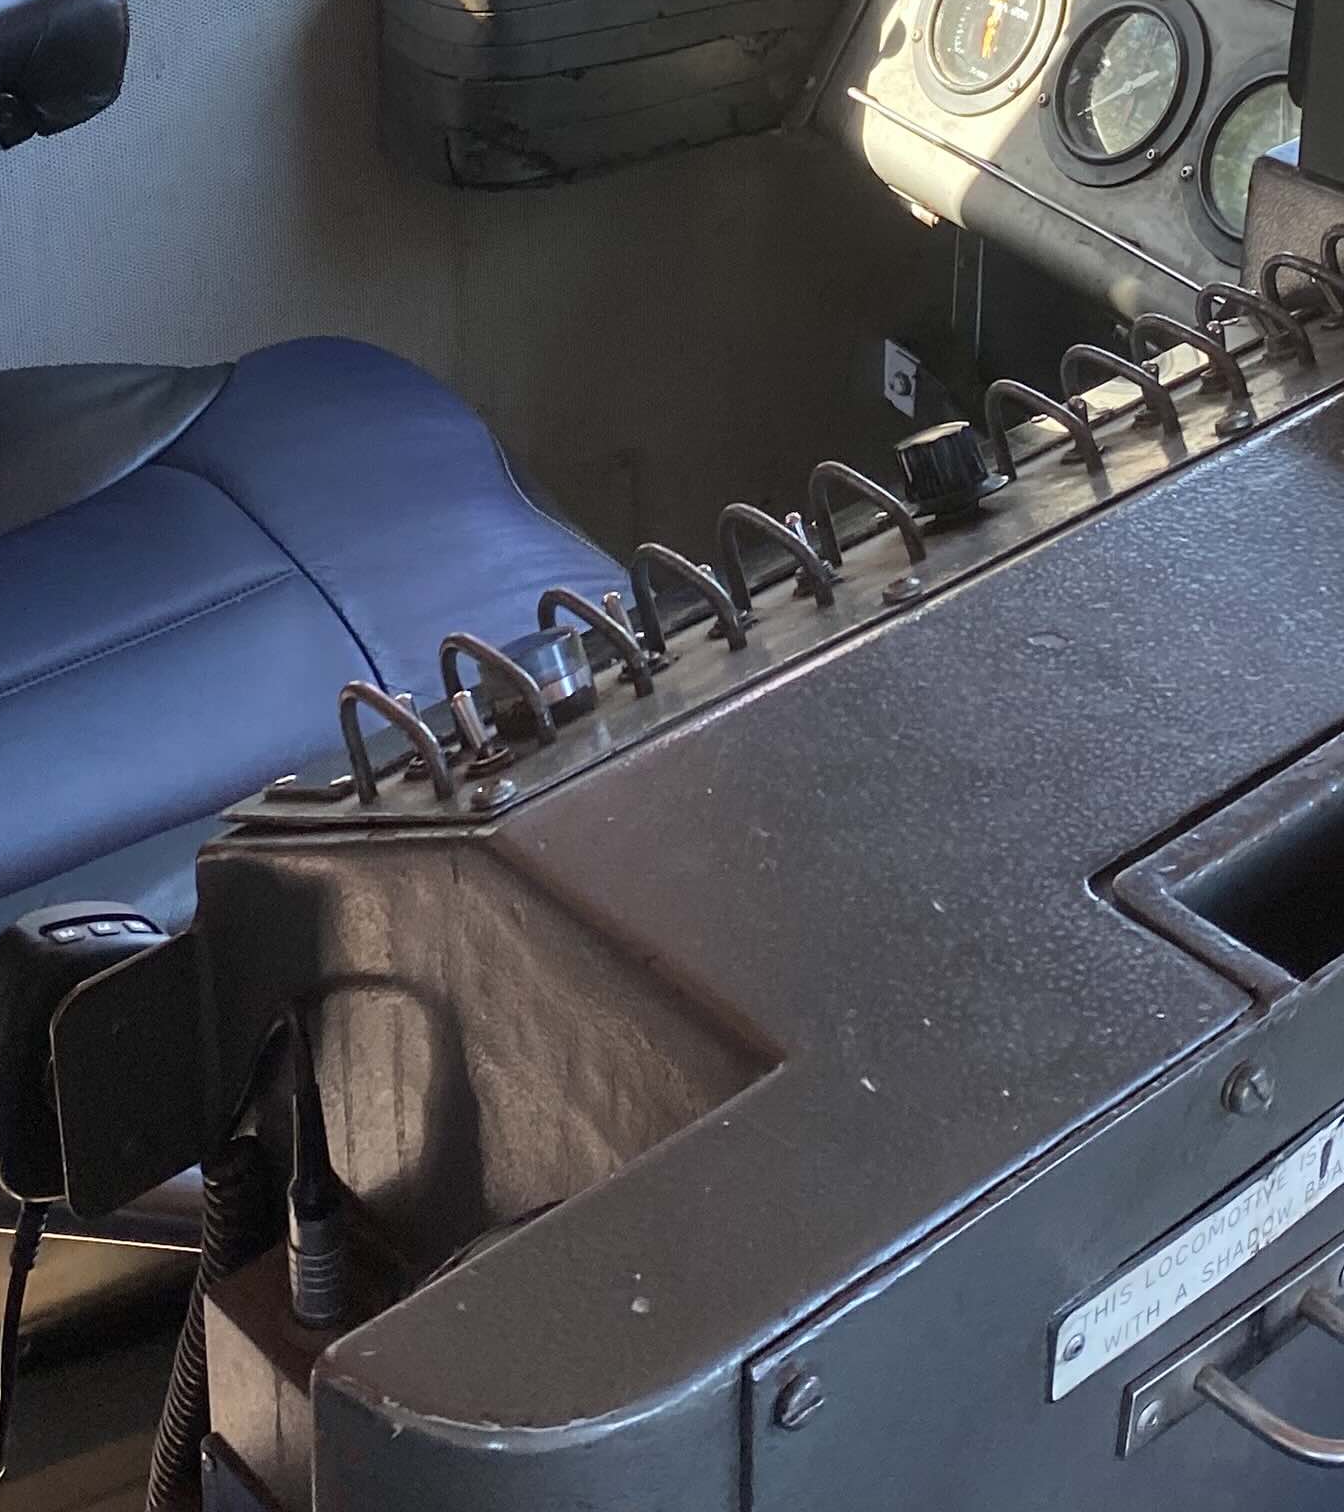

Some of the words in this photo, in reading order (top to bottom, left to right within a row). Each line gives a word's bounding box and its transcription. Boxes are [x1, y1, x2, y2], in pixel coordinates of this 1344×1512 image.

[1081, 1283, 1133, 1333] THIS
[1145, 1164, 1288, 1290] LOCOMOTIVE
[1299, 1144, 1317, 1173] IS
[1104, 1299, 1160, 1353] WITH
[1175, 1283, 1188, 1306] A
[1201, 1198, 1293, 1284] SHADOW
